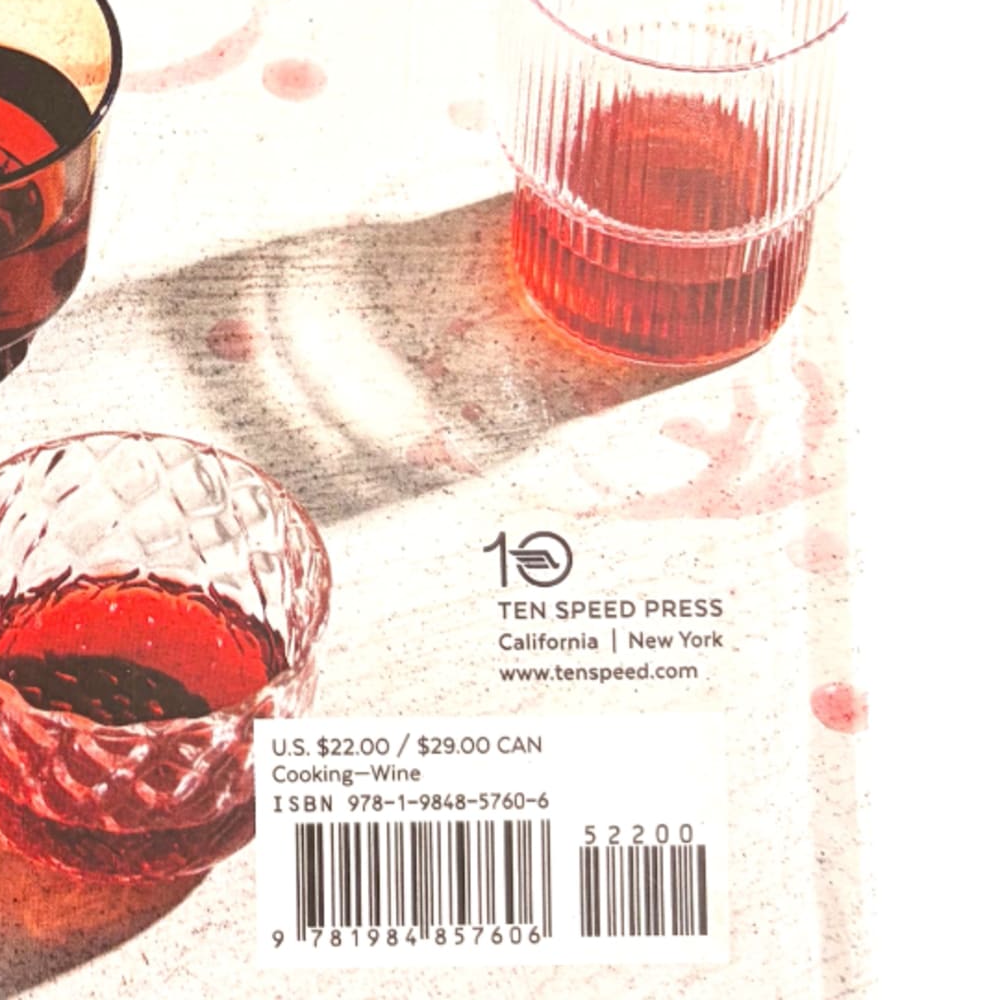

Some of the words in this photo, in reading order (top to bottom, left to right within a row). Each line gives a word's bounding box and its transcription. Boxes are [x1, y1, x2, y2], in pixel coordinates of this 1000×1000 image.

[498, 601, 546, 620] TEN
[555, 600, 636, 620] SPEED
[645, 598, 723, 618] PRESS
[498, 632, 600, 652] California
[628, 633, 673, 650] New
[679, 631, 723, 649] York
[499, 662, 699, 684] www.tenspeed.com
[272, 738, 311, 757] U.S.
[317, 736, 391, 759] $22.00
[417, 735, 491, 757] $29.00
[497, 736, 543, 755] CAN
[273, 795, 334, 813] ISBN
[347, 792, 550, 812] 978-1-9848-5760-6
[584, 824, 695, 845] 52200
[272, 930, 286, 948] 9
[312, 928, 418, 947] 781984
[435, 926, 542, 945] 857606
